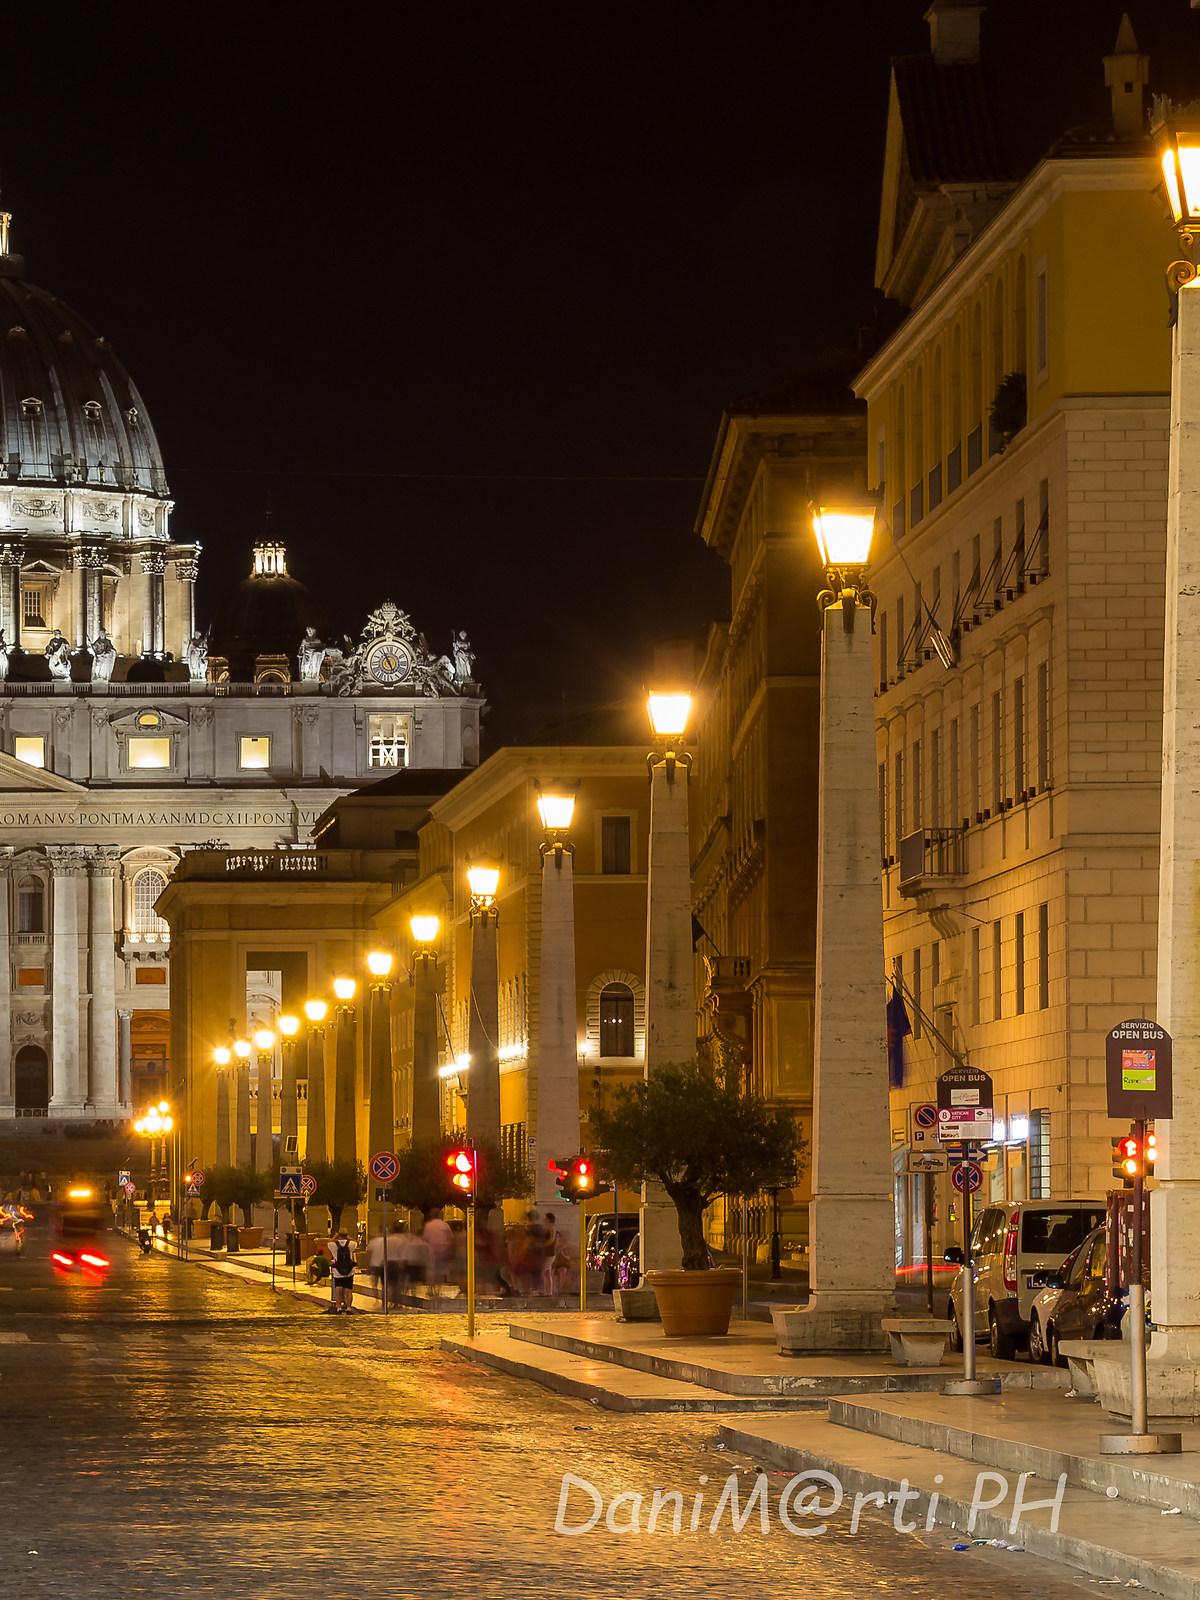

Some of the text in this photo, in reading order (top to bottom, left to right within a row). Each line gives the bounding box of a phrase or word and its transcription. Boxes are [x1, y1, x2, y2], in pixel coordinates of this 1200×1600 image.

[184, 812, 248, 825] MDCXII
[1112, 1030, 1164, 1040] OPEN BUS
[942, 1074, 986, 1082] OPEN BUS
